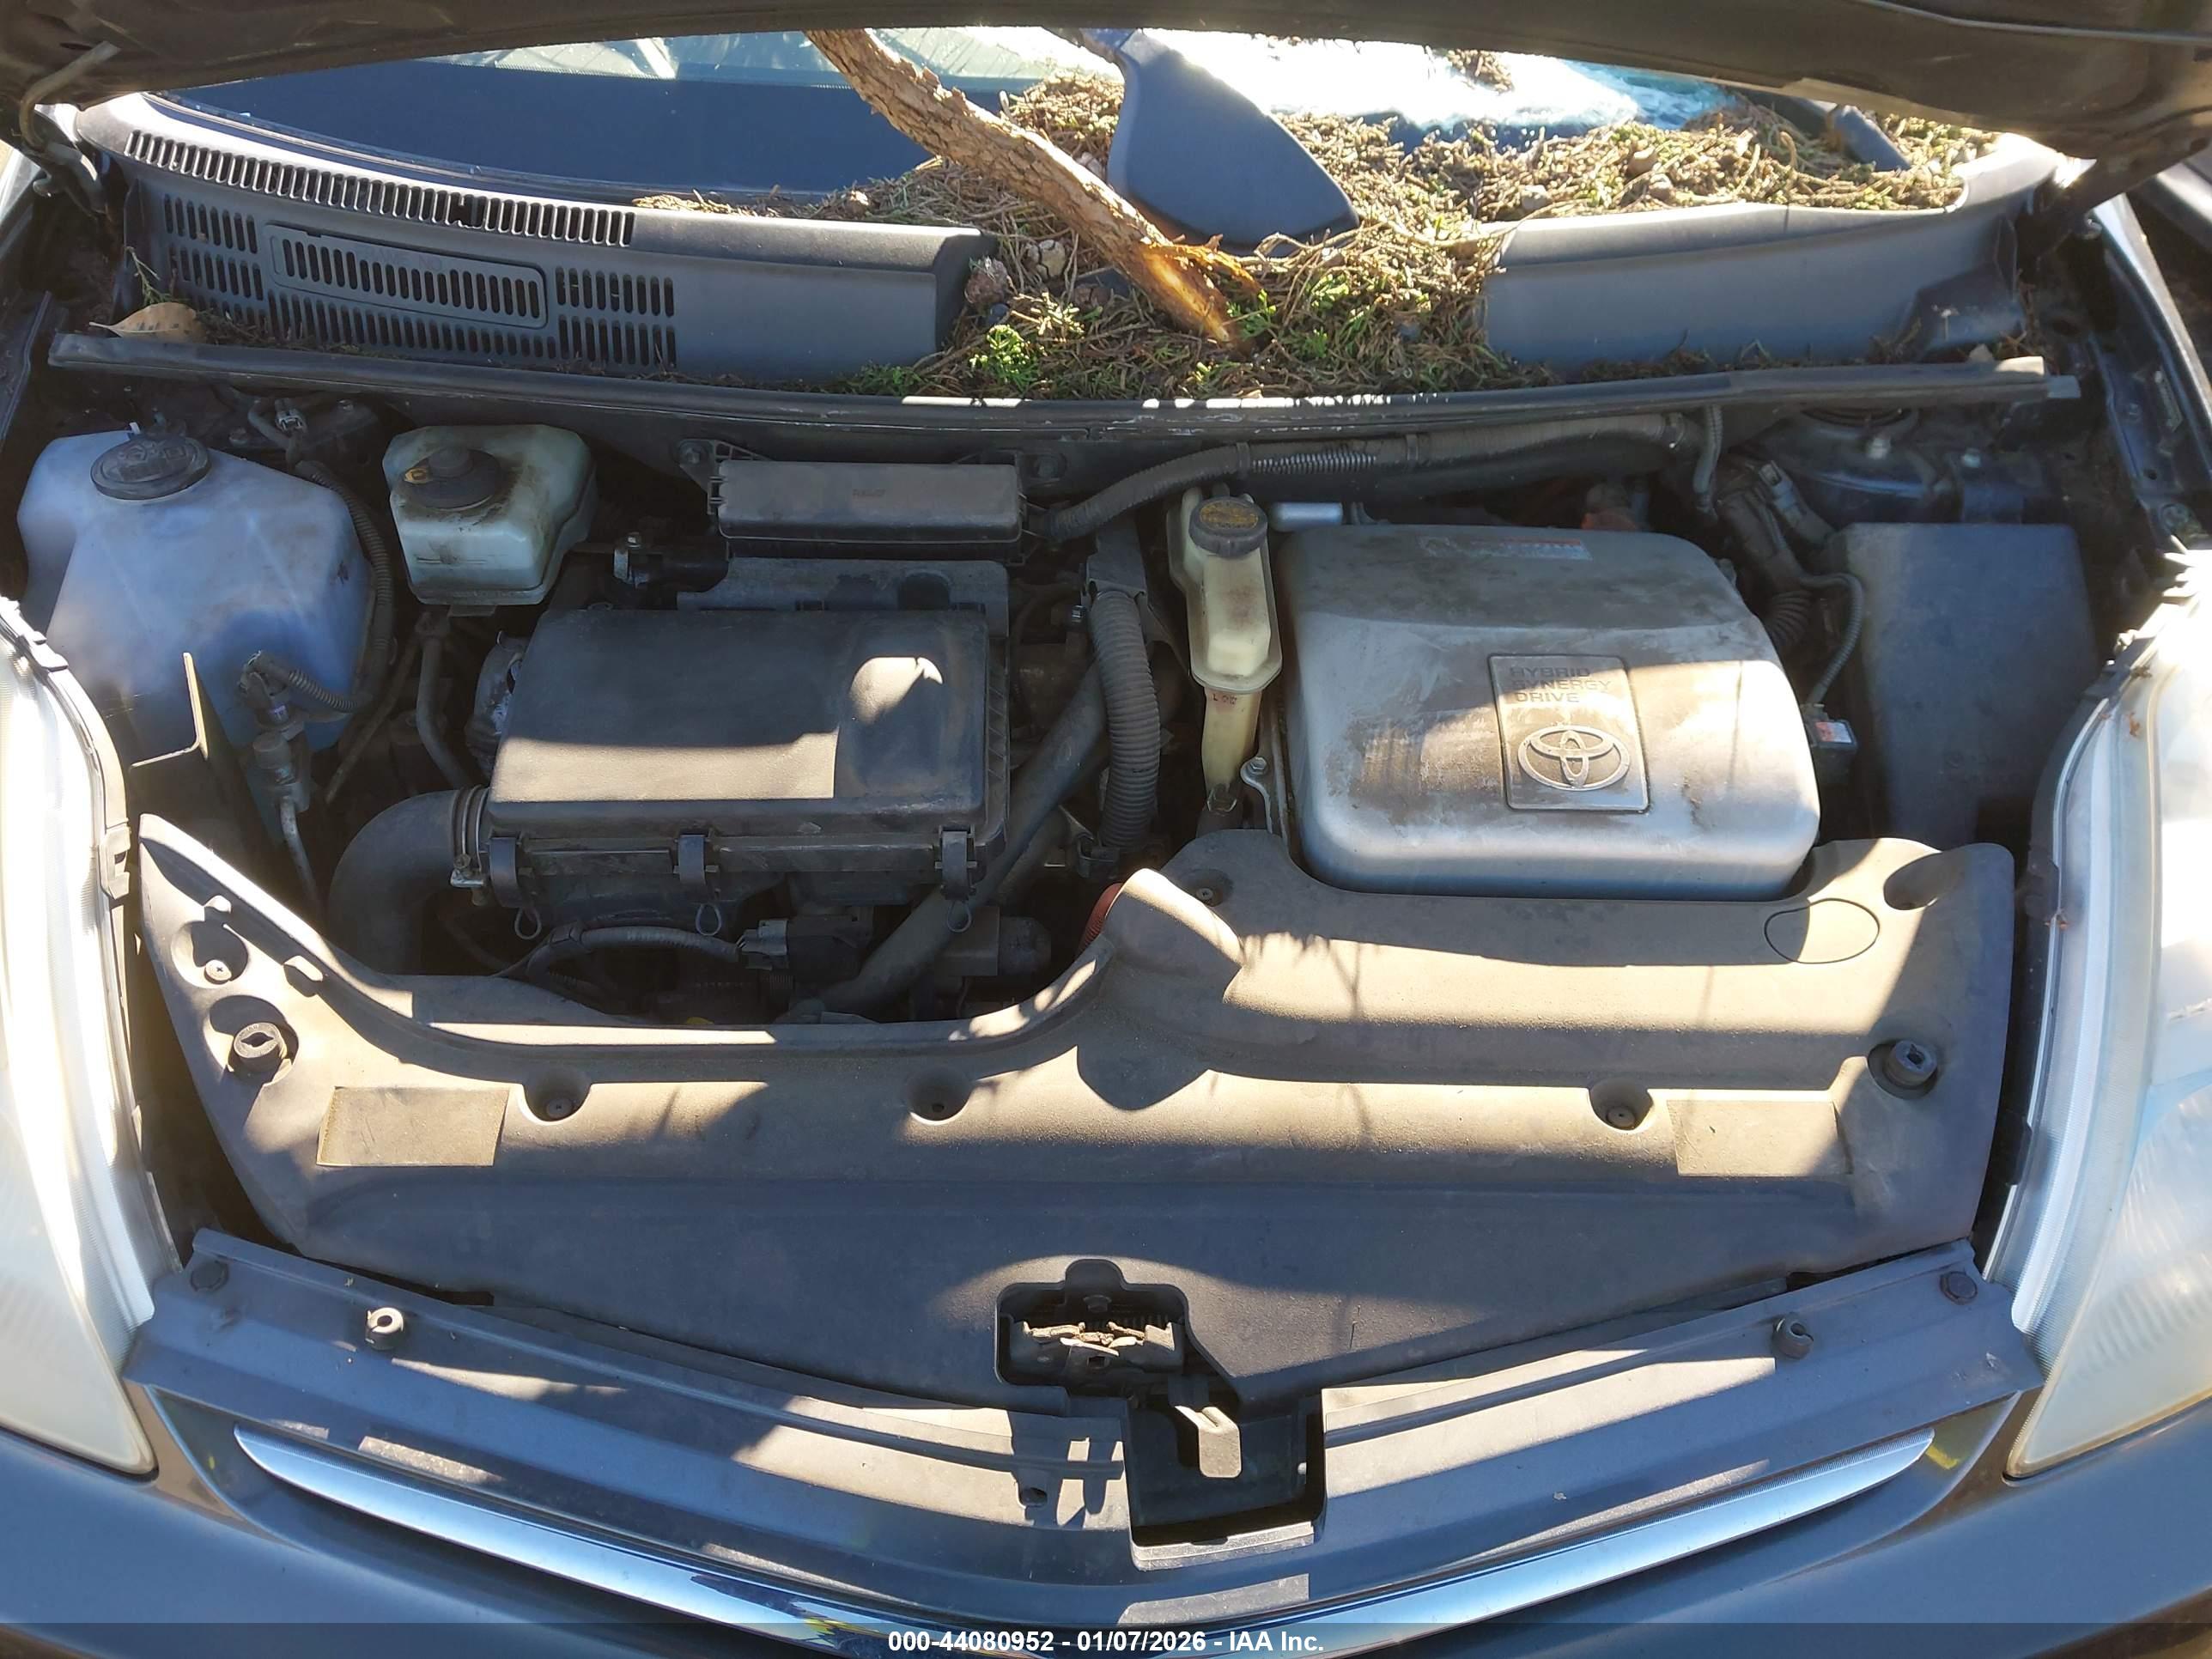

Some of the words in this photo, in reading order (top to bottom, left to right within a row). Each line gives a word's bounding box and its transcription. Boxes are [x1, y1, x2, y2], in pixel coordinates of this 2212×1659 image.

[1510, 666, 1590, 678] HYBRID
[1511, 679, 1612, 690] SYNERGY
[1516, 692, 1580, 702] DRIVE
